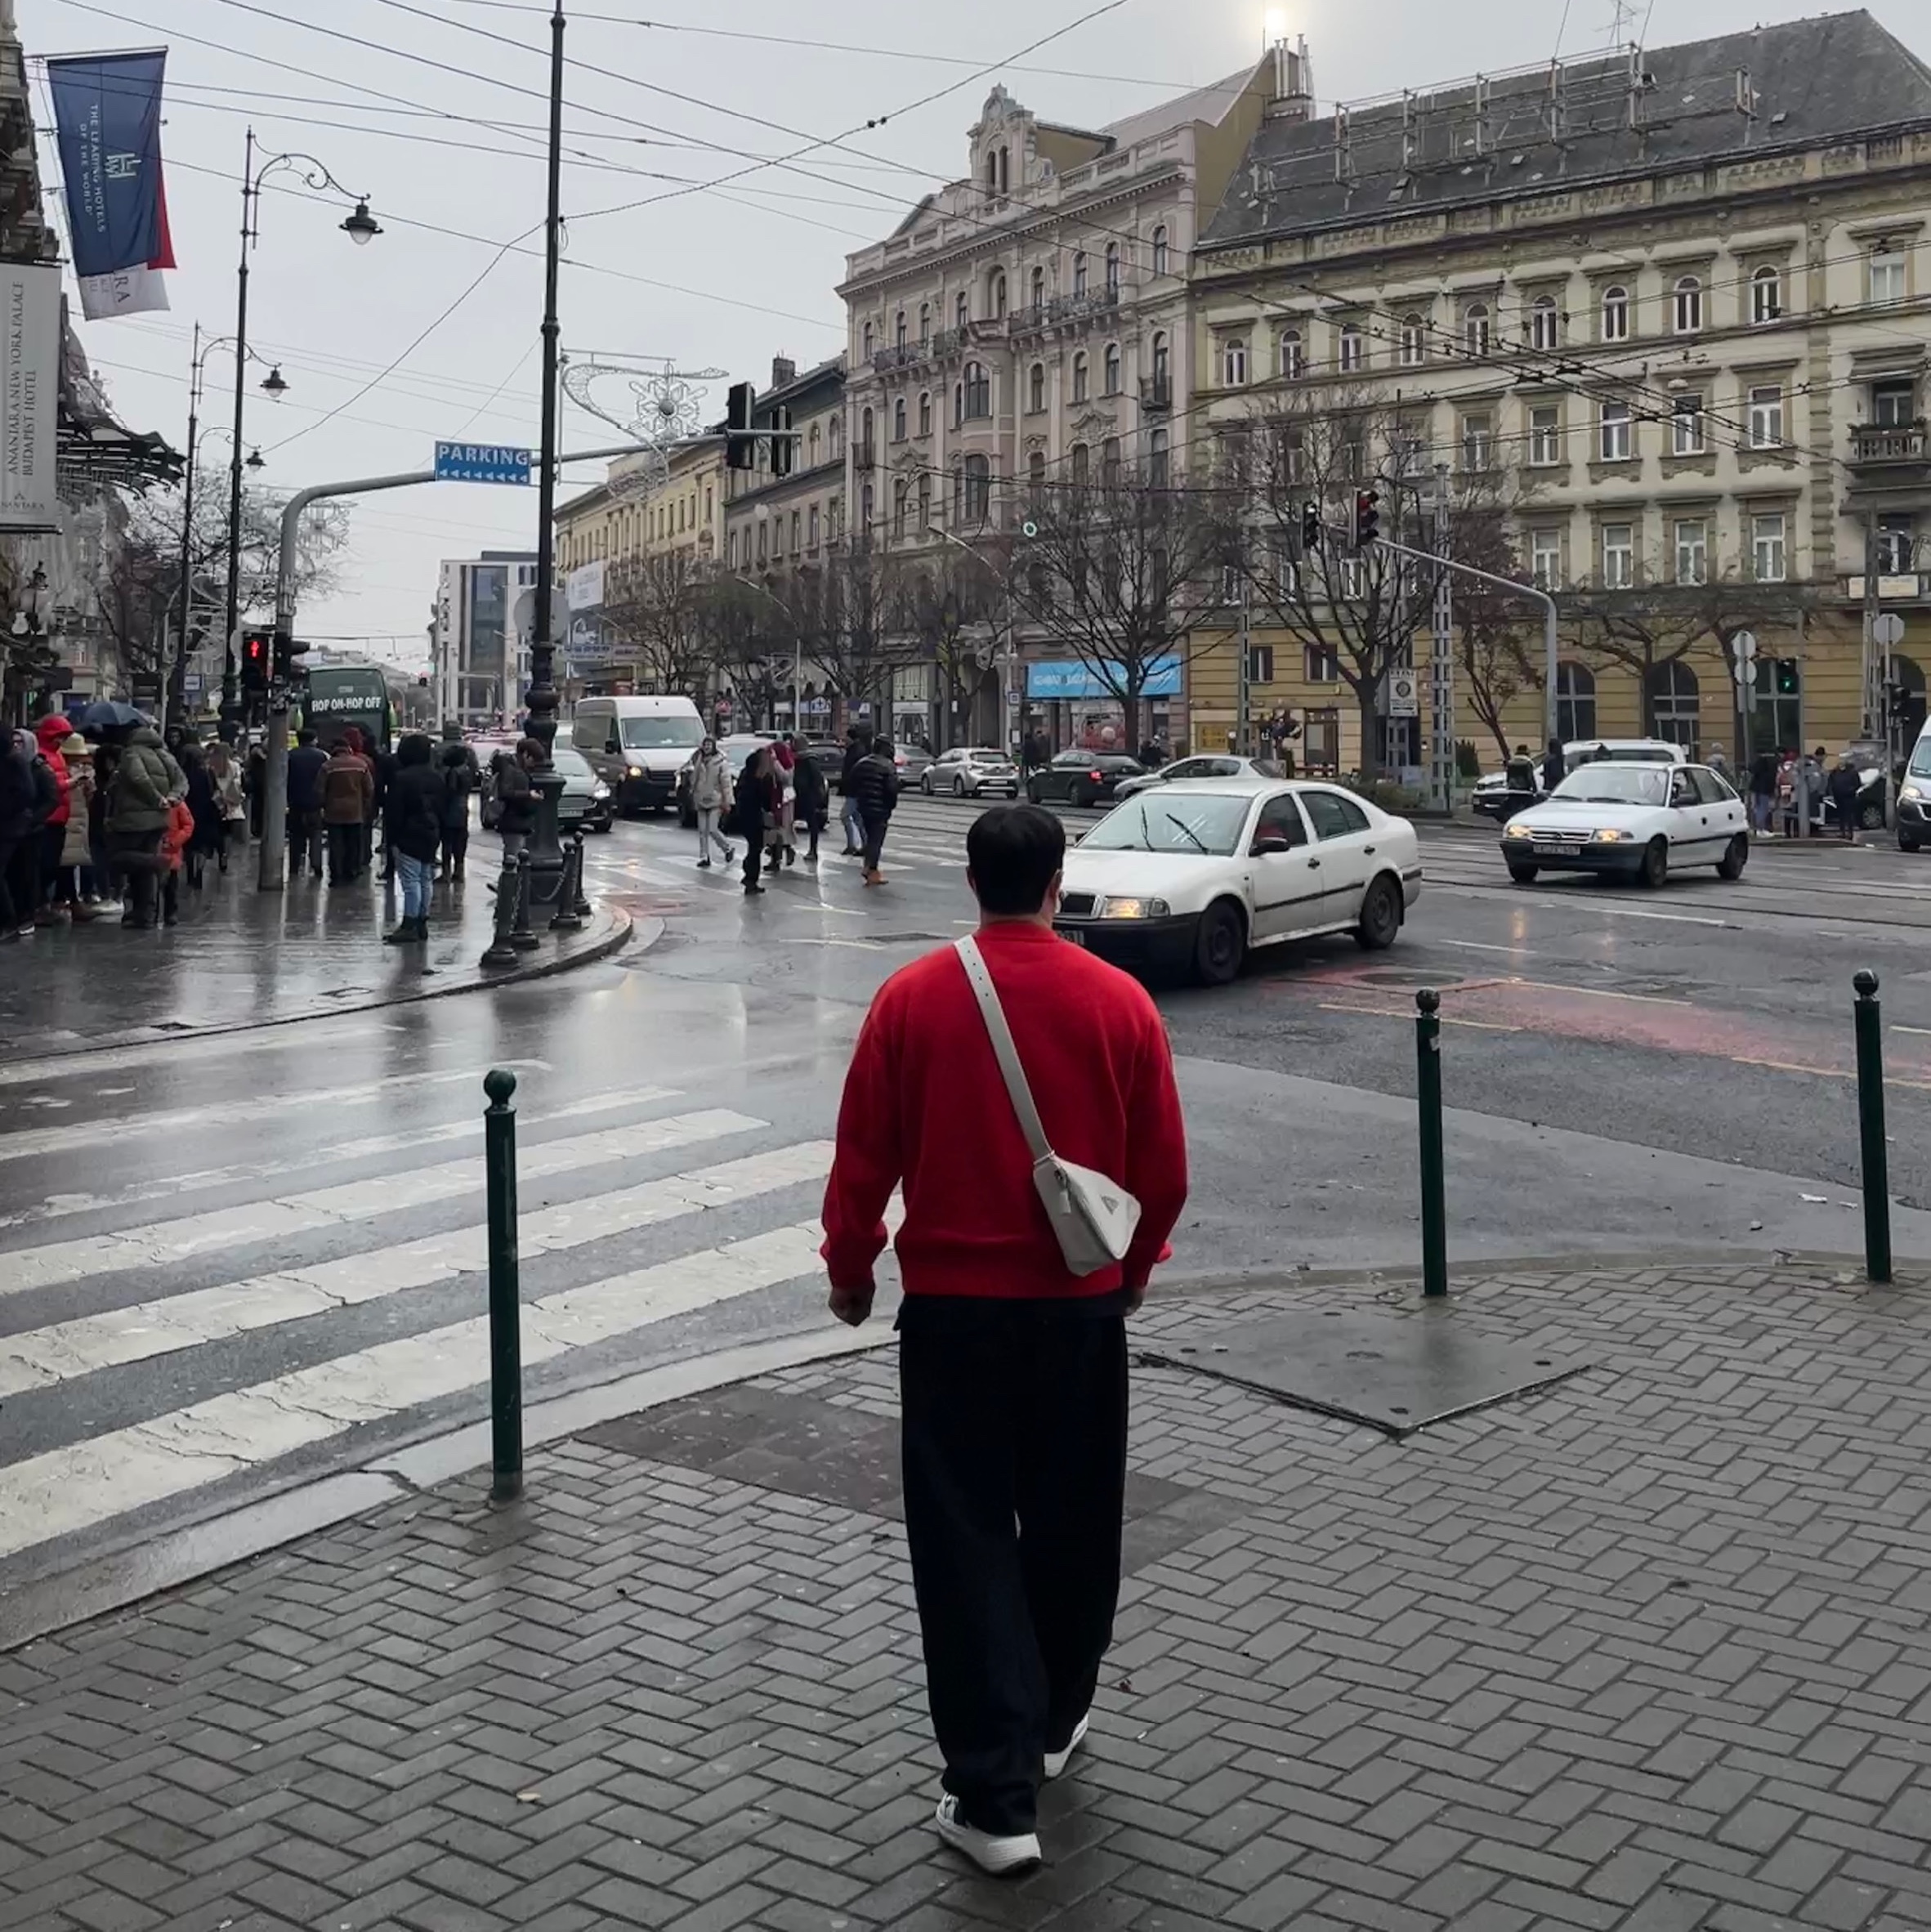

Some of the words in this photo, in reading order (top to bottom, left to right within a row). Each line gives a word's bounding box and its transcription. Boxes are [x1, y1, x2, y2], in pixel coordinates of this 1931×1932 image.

[79, 123, 87, 139] OF
[90, 105, 98, 126] THE
[81, 145, 89, 167] THE
[91, 131, 101, 183] LEADING
[94, 186, 105, 233] HOTELS
[11, 281, 24, 327] PALACE
[11, 330, 22, 365] YORK
[10, 370, 20, 399] NEW
[25, 370, 36, 410] HOTEL
[8, 403, 20, 476] ANANTARA
[22, 415, 34, 476] BUDAPEST
[439, 445, 528, 466] PARKING
[311, 699, 330, 713] HOP
[364, 696, 382, 709] OFF
